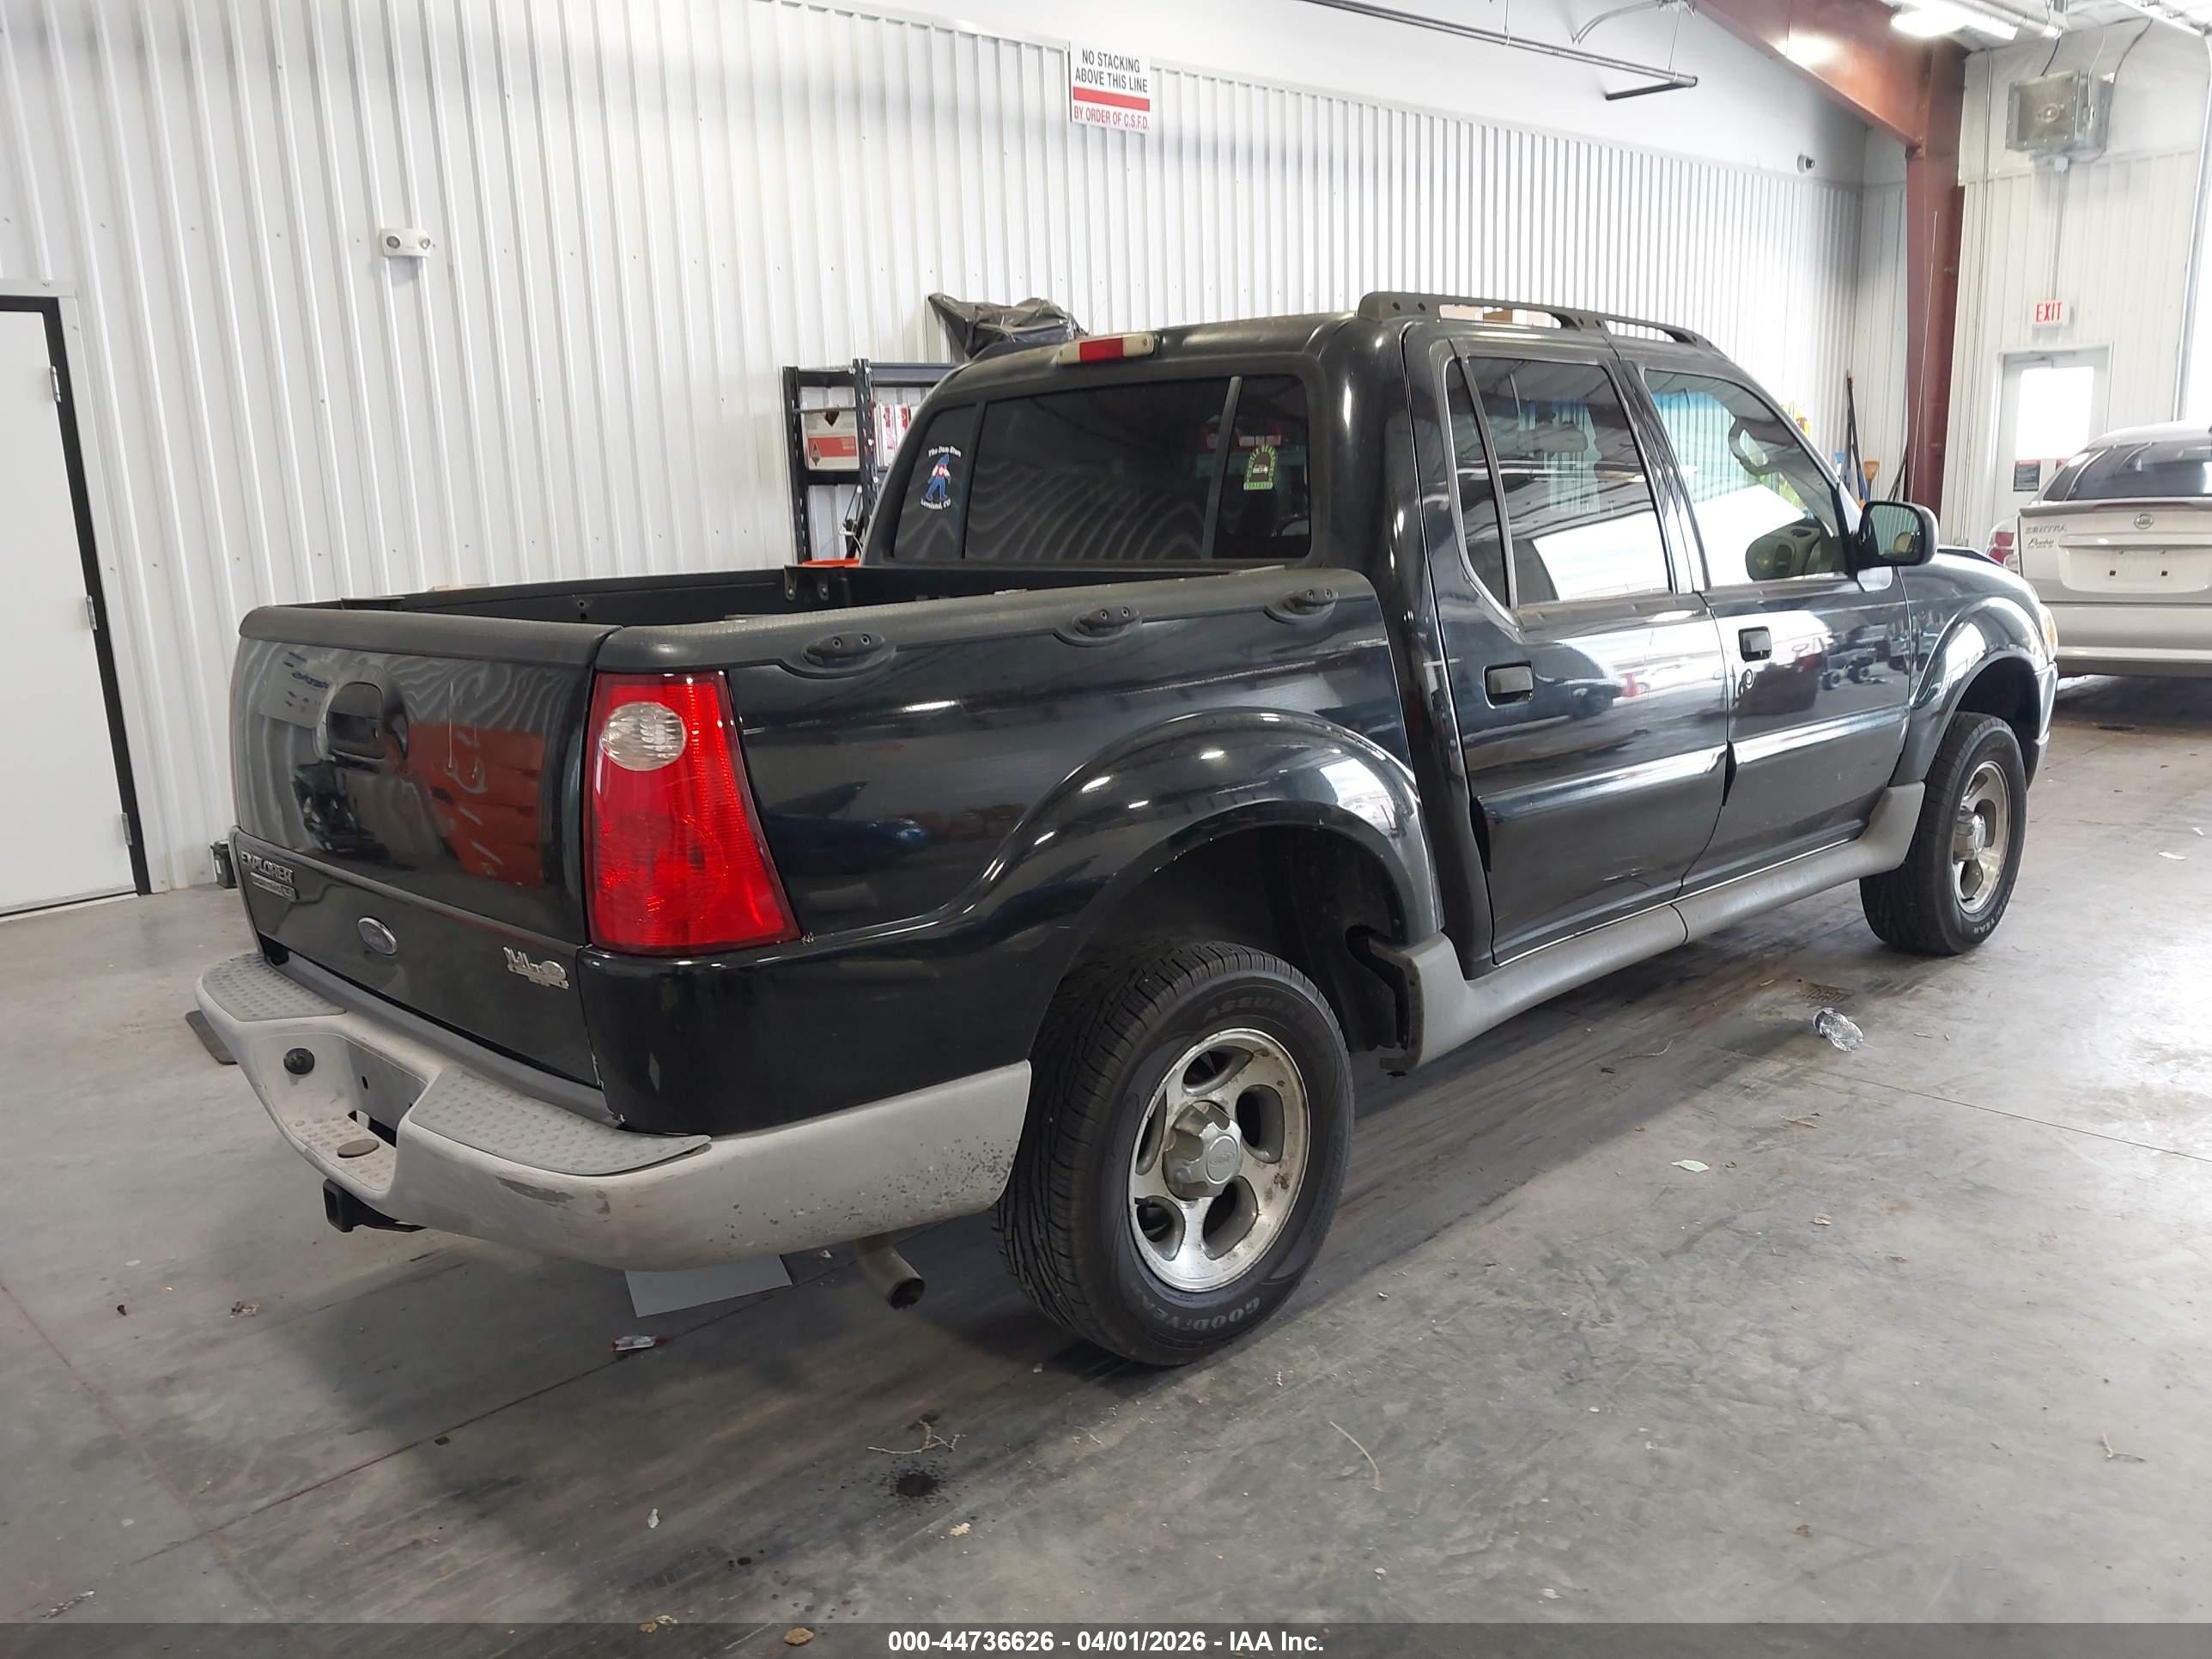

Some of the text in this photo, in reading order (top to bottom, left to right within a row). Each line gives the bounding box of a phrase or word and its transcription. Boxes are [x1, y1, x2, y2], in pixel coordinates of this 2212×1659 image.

[1082, 48, 1140, 73] NO STACKING
[1075, 67, 1148, 93] ABOVE THIS LINE
[1073, 105, 1084, 119] BY
[1085, 107, 1111, 125] ORDER
[1113, 112, 1122, 128] OF
[2036, 301, 2063, 323] EXIT
[240, 850, 294, 884] EXPLORER
